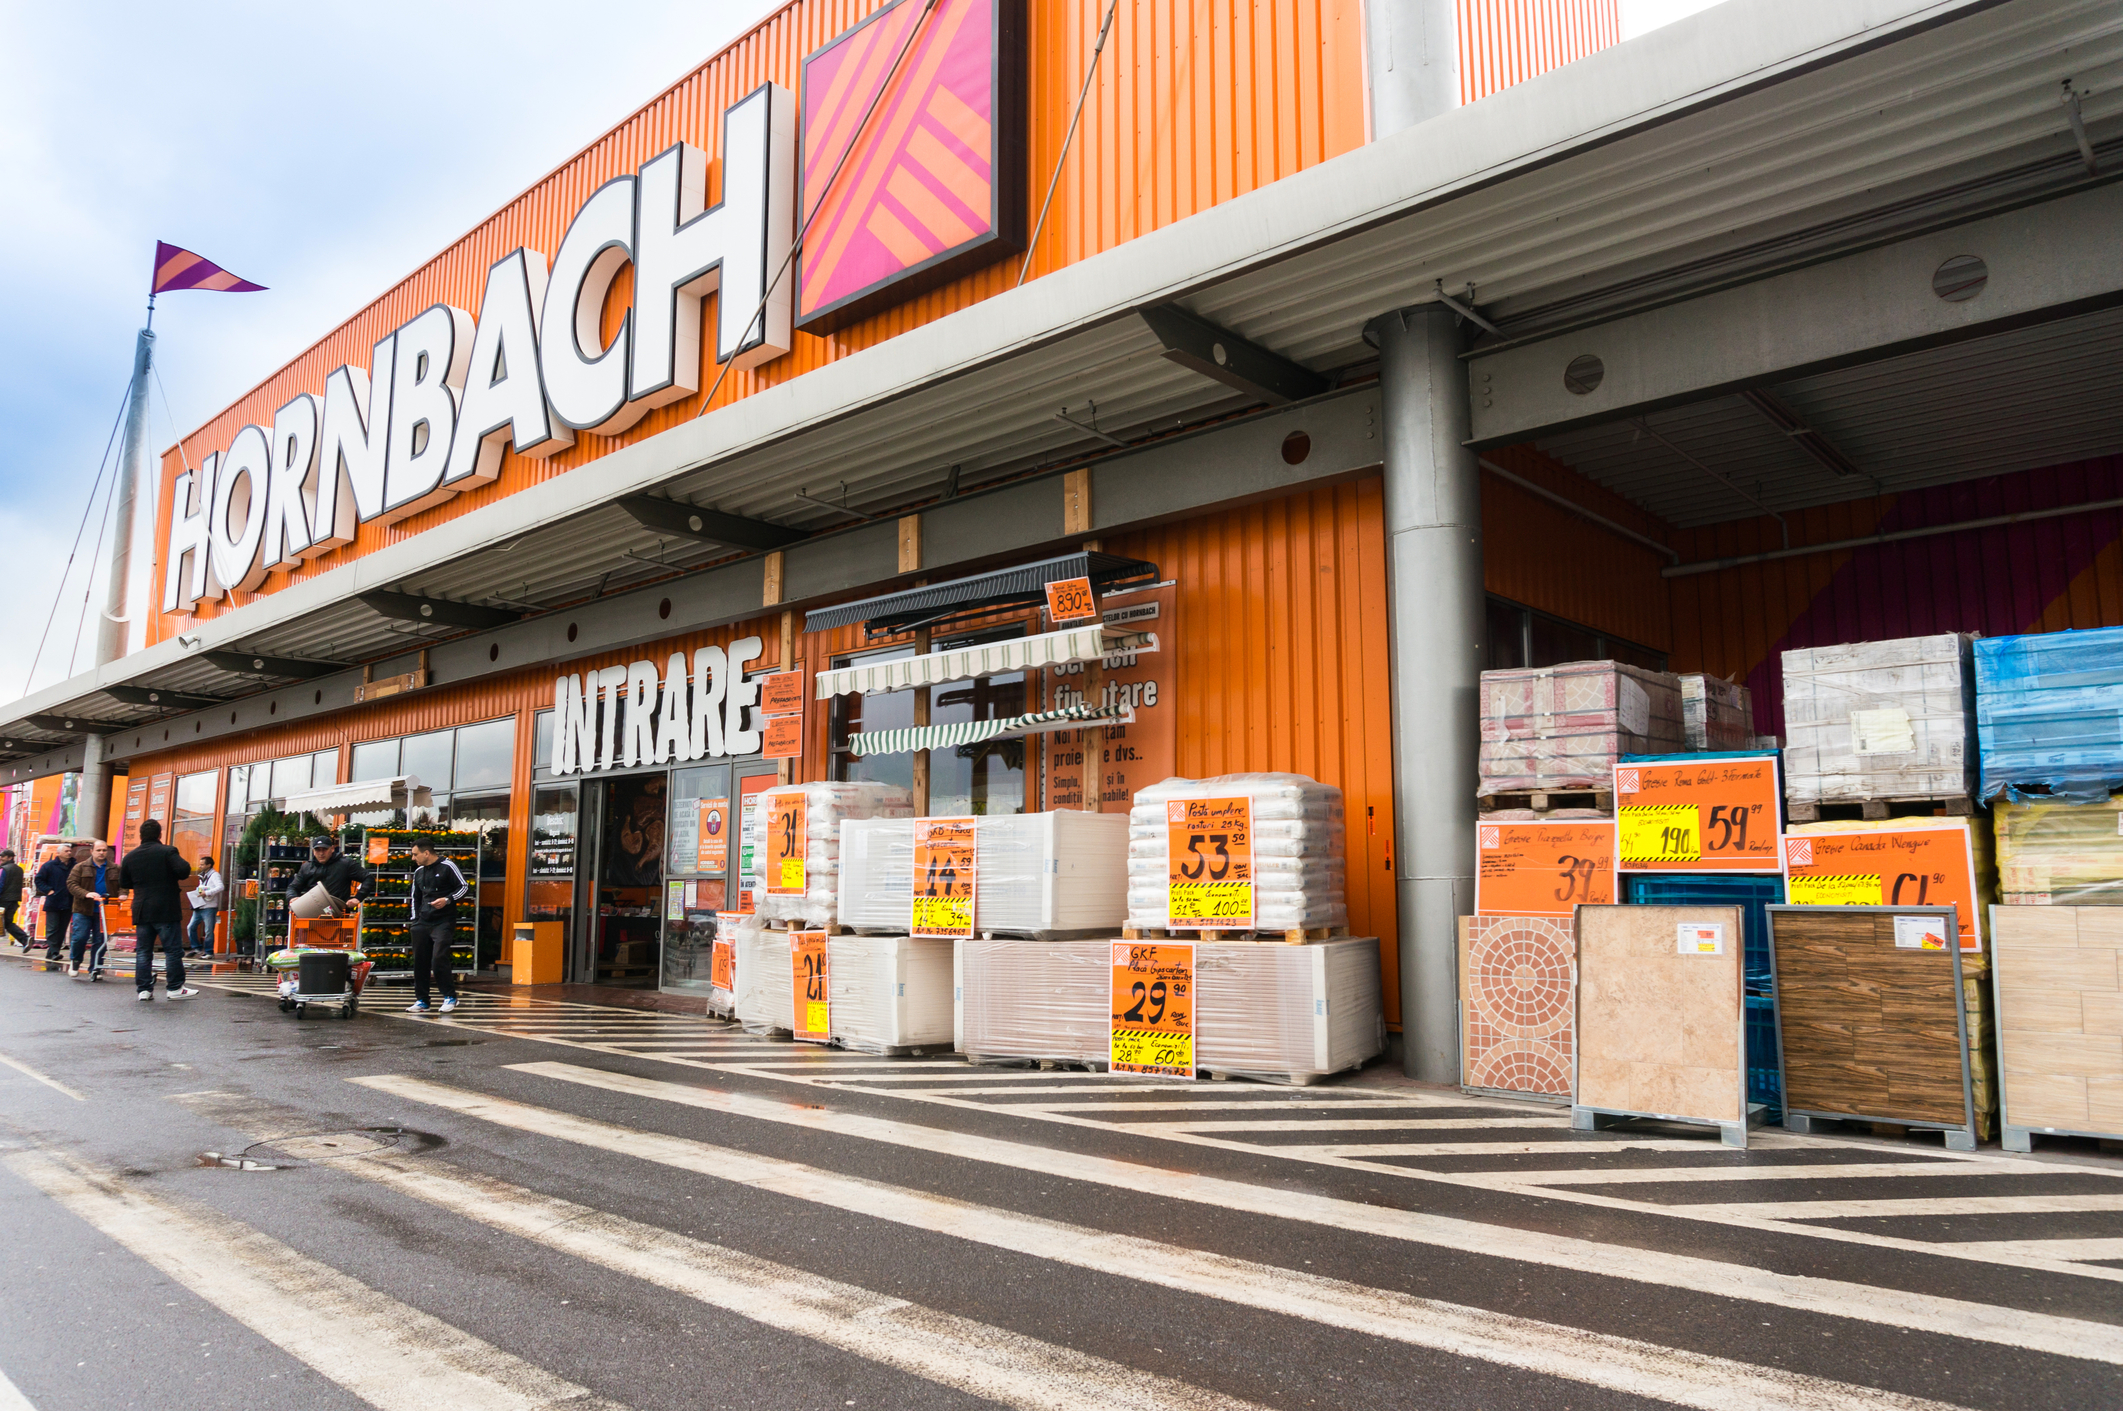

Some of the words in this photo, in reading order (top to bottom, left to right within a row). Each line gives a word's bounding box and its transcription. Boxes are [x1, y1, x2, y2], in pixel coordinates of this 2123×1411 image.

[162, 80, 780, 614] HORNBACH
[1121, 610, 1128, 620] CU
[1129, 606, 1156, 619] HORNBACH
[551, 636, 763, 776] INTRARE
[1054, 730, 1071, 746] Noi
[780, 808, 798, 858] 31
[1660, 826, 1690, 855] 190
[1708, 805, 1749, 851] 59
[1750, 804, 1763, 814] 99
[925, 856, 957, 896] 14
[1554, 855, 1596, 902] 39
[946, 912, 963, 926] 34
[1131, 946, 1157, 960] GKF
[804, 953, 823, 1000] 21
[1173, 983, 1186, 993] 90
[1117, 1049, 1132, 1062] 28
